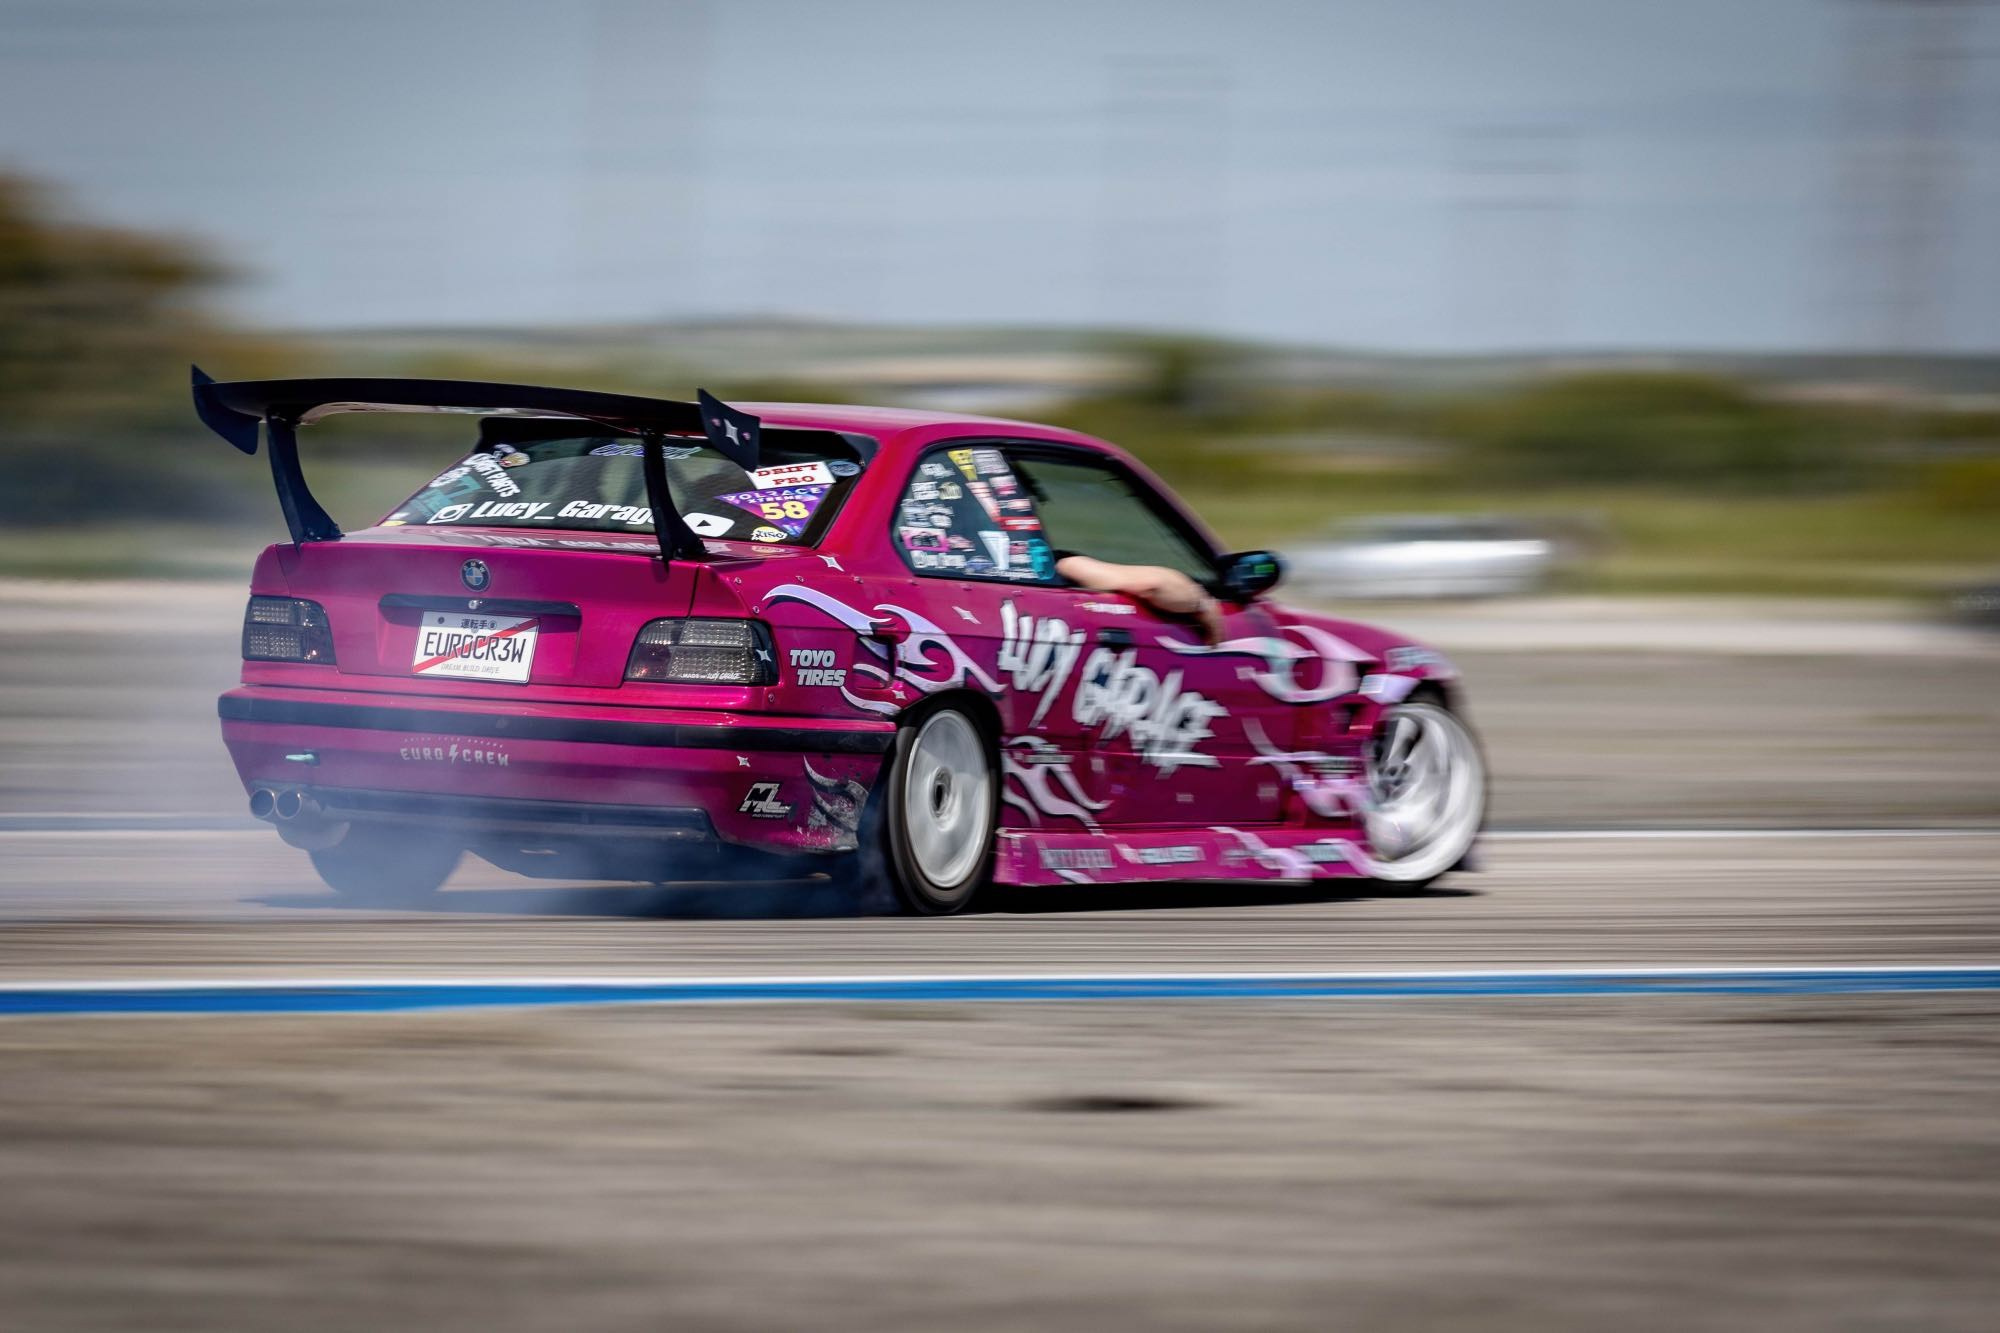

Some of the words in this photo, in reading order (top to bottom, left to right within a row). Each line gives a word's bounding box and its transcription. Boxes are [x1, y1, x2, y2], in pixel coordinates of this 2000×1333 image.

[757, 464, 818, 477] DRIFT
[772, 475, 815, 485] PRO
[760, 500, 810, 519] 58
[423, 632, 527, 663] EUROCR3W
[789, 650, 836, 668] TOYO
[797, 669, 847, 687] TIRES
[400, 747, 444, 761] EURO
[461, 748, 509, 766] CREW
